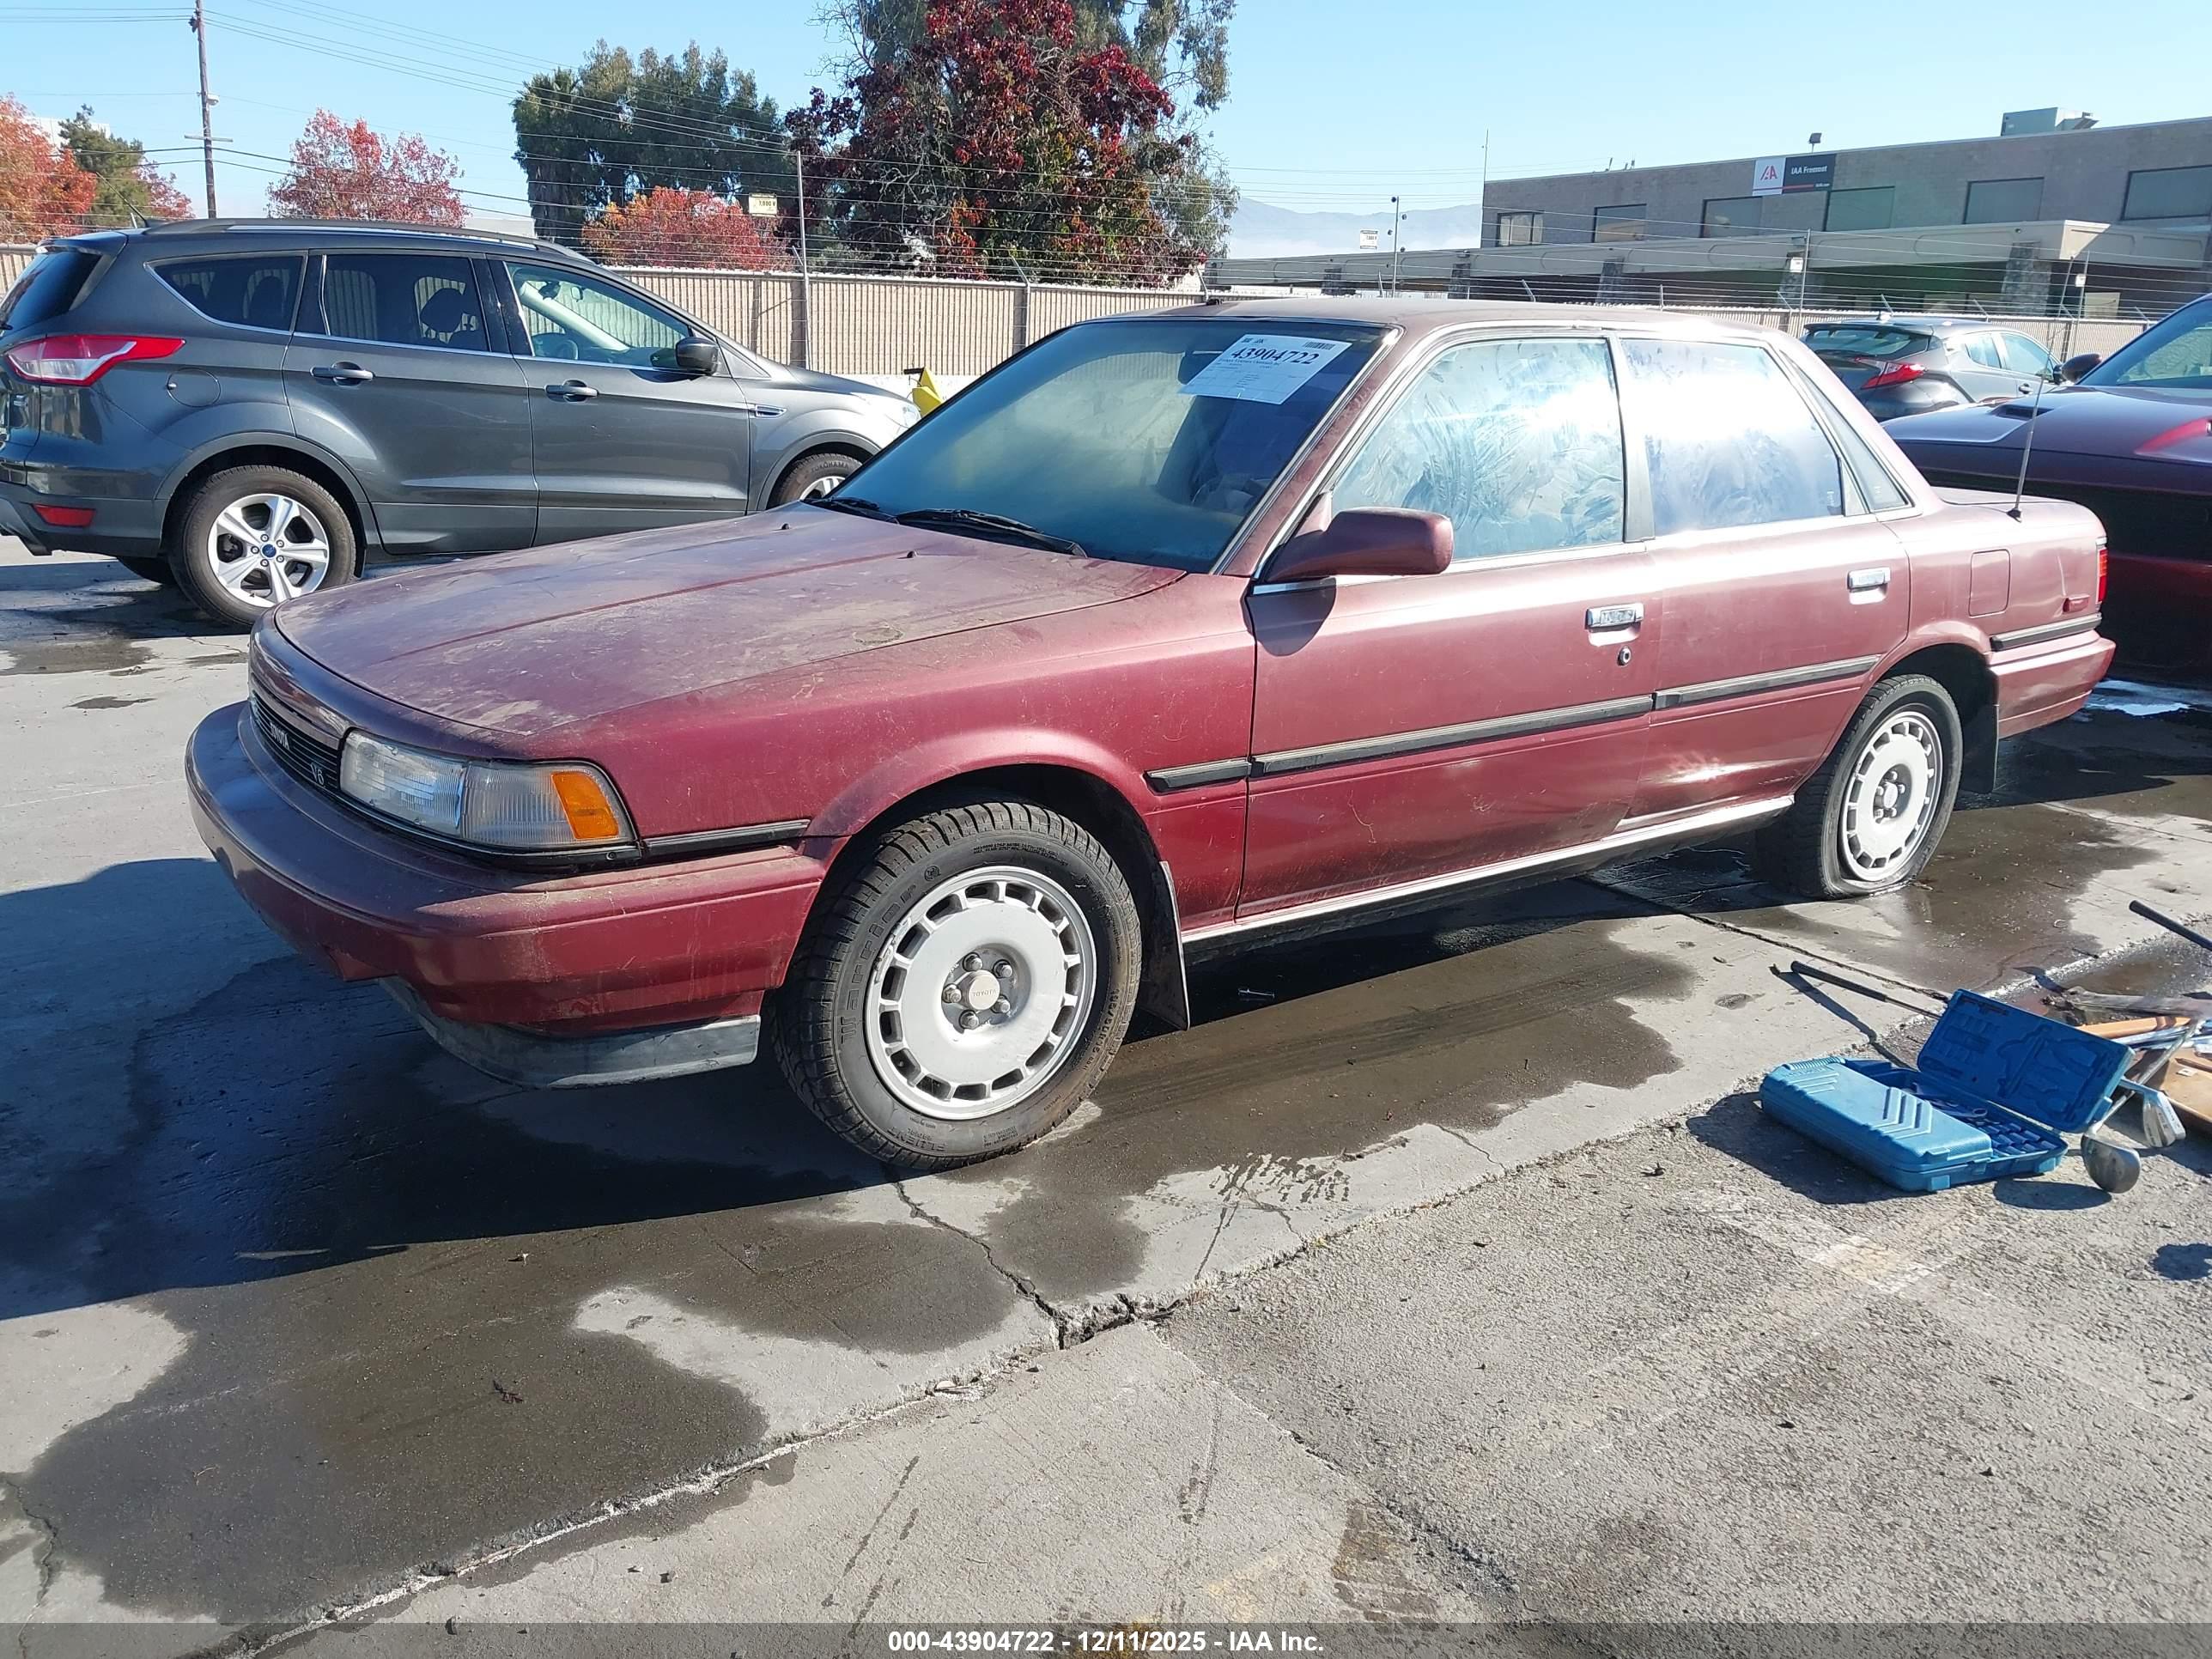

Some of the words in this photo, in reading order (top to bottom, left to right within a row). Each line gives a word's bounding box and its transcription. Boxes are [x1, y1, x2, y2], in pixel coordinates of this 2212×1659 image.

[1790, 167, 1802, 175] IAA
[1803, 165, 1828, 174] Fremont
[1231, 347, 1320, 365] 43904722
[270, 721, 290, 751] TOYOTA
[309, 762, 325, 786] V6
[972, 988, 997, 998] TOYOTA
